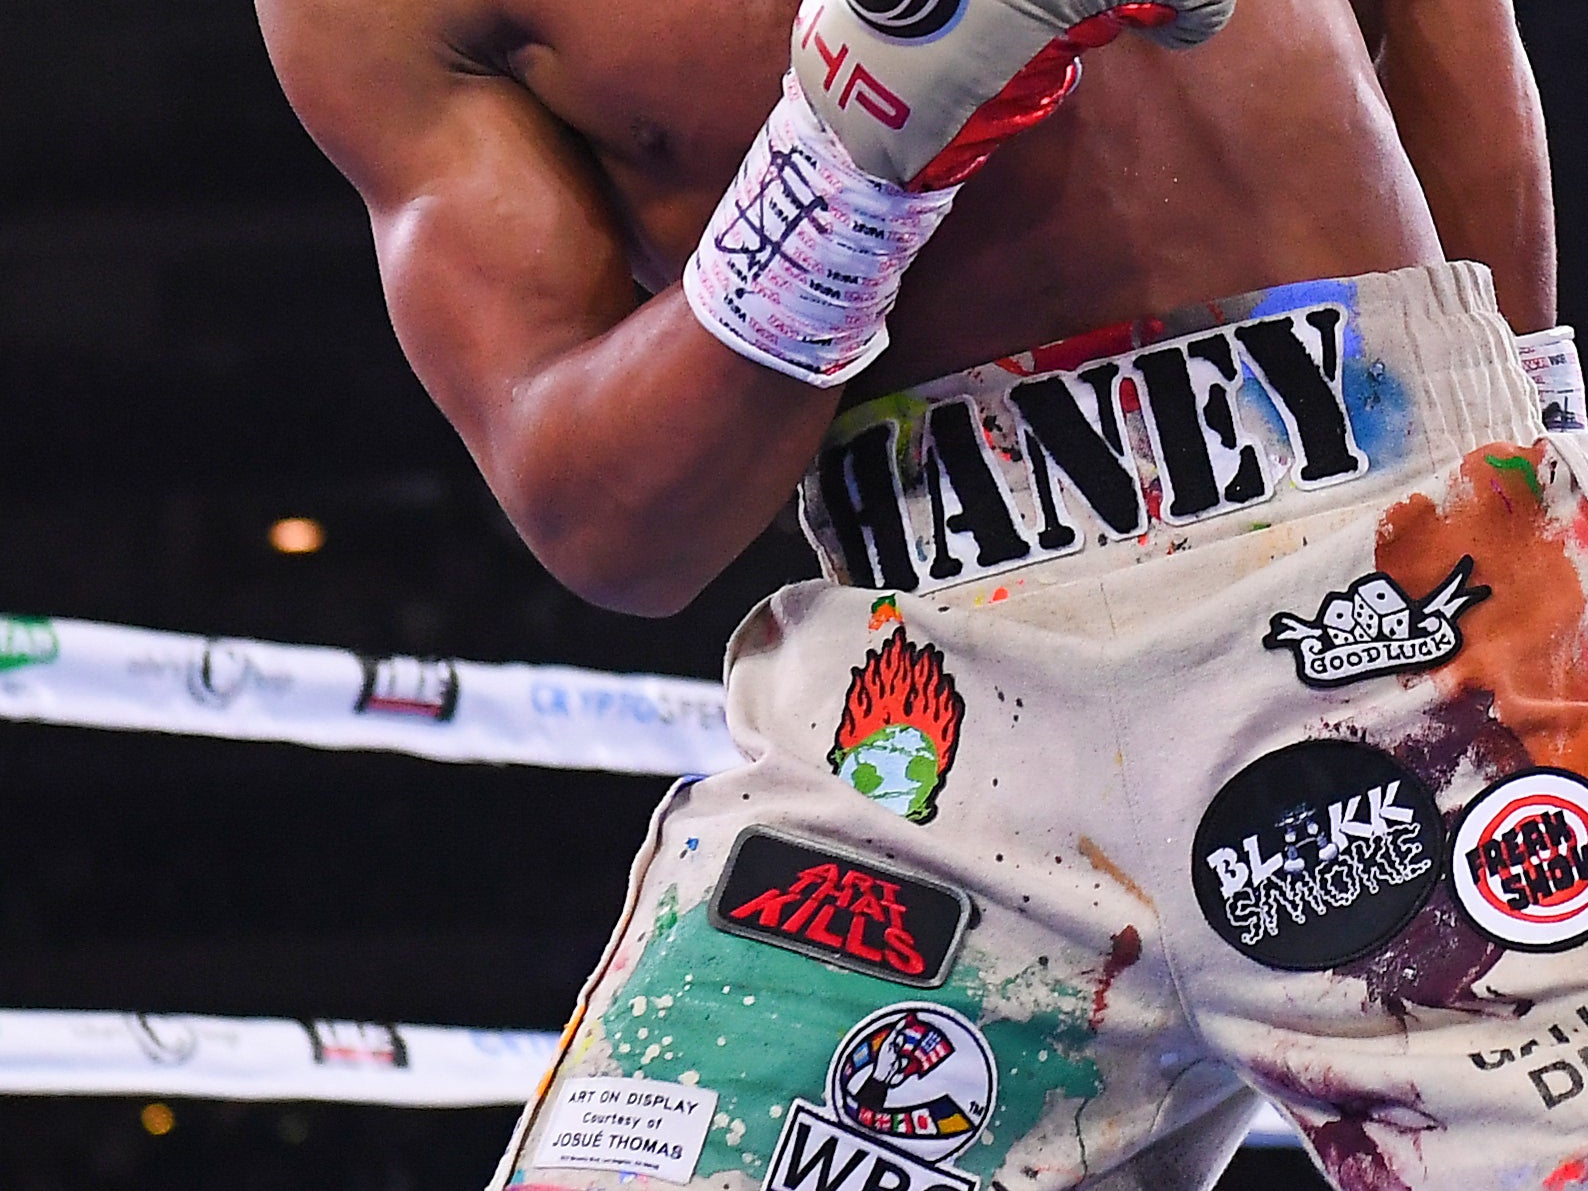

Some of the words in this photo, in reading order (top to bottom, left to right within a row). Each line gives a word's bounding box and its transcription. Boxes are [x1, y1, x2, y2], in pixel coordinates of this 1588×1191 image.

[820, 304, 1362, 592] HANEY
[1464, 809, 1573, 885] FREAK
[788, 872, 907, 931] THAT
[794, 862, 901, 904] ART
[1226, 821, 1432, 945] SMOKE
[730, 888, 927, 975] KILLS
[567, 1090, 595, 1104] ART
[600, 1090, 620, 1104] ON
[626, 1092, 698, 1116] DISPLAY
[582, 1111, 641, 1129] Courtesy
[646, 1117, 663, 1129] of
[552, 1129, 604, 1149] JOSUÉ
[608, 1134, 684, 1161] THOMAS
